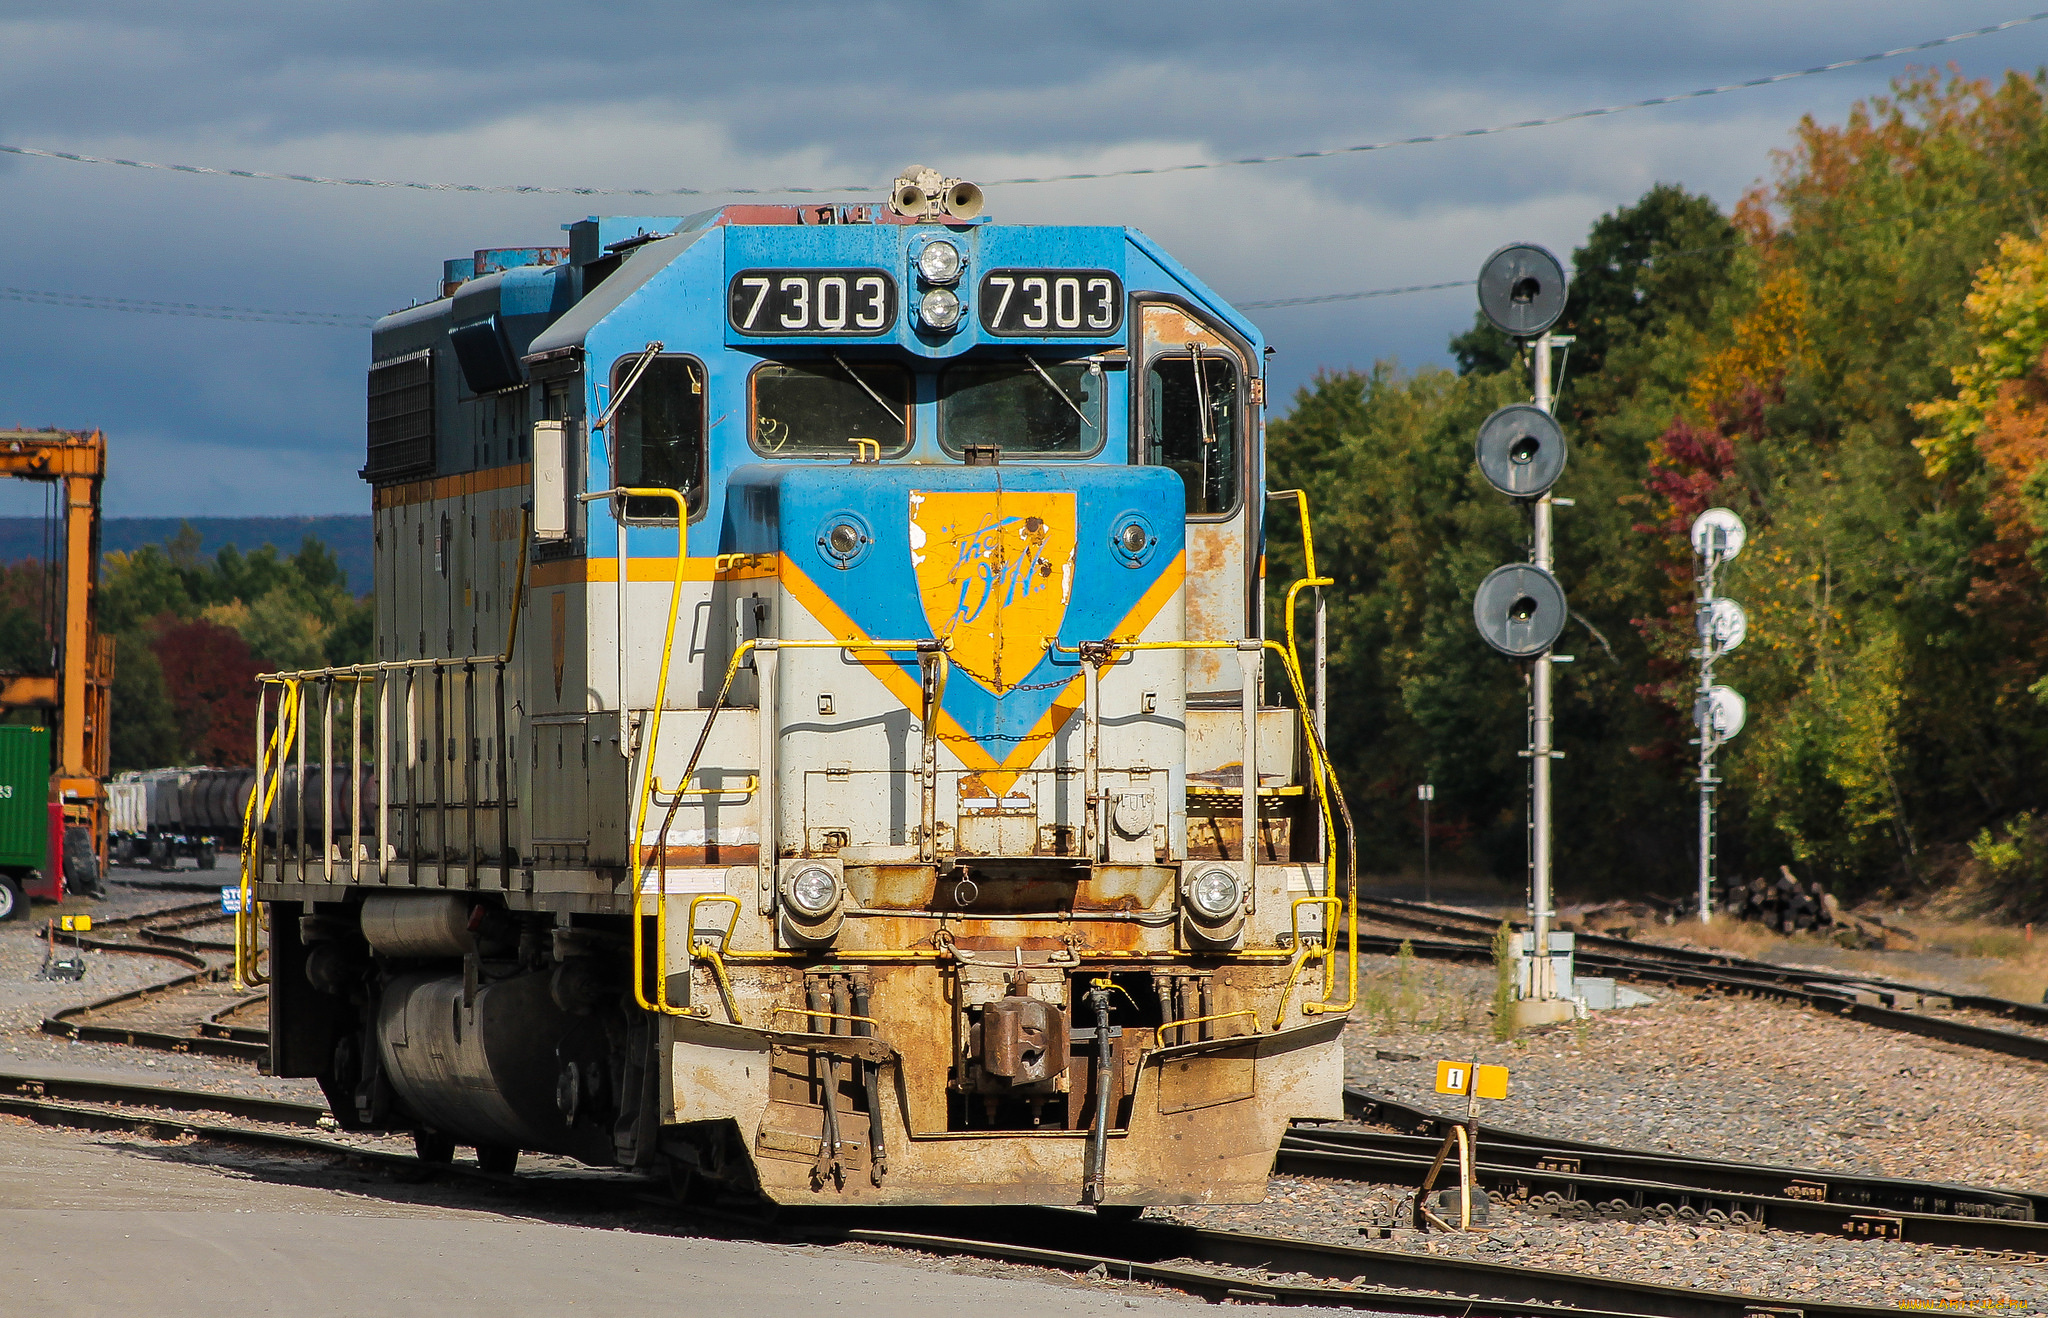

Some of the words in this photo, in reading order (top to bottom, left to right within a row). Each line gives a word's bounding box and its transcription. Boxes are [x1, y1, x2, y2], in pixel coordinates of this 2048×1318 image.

[742, 277, 885, 329] 7303
[990, 277, 1113, 329] 7303
[1451, 1070, 1458, 1088] 1
